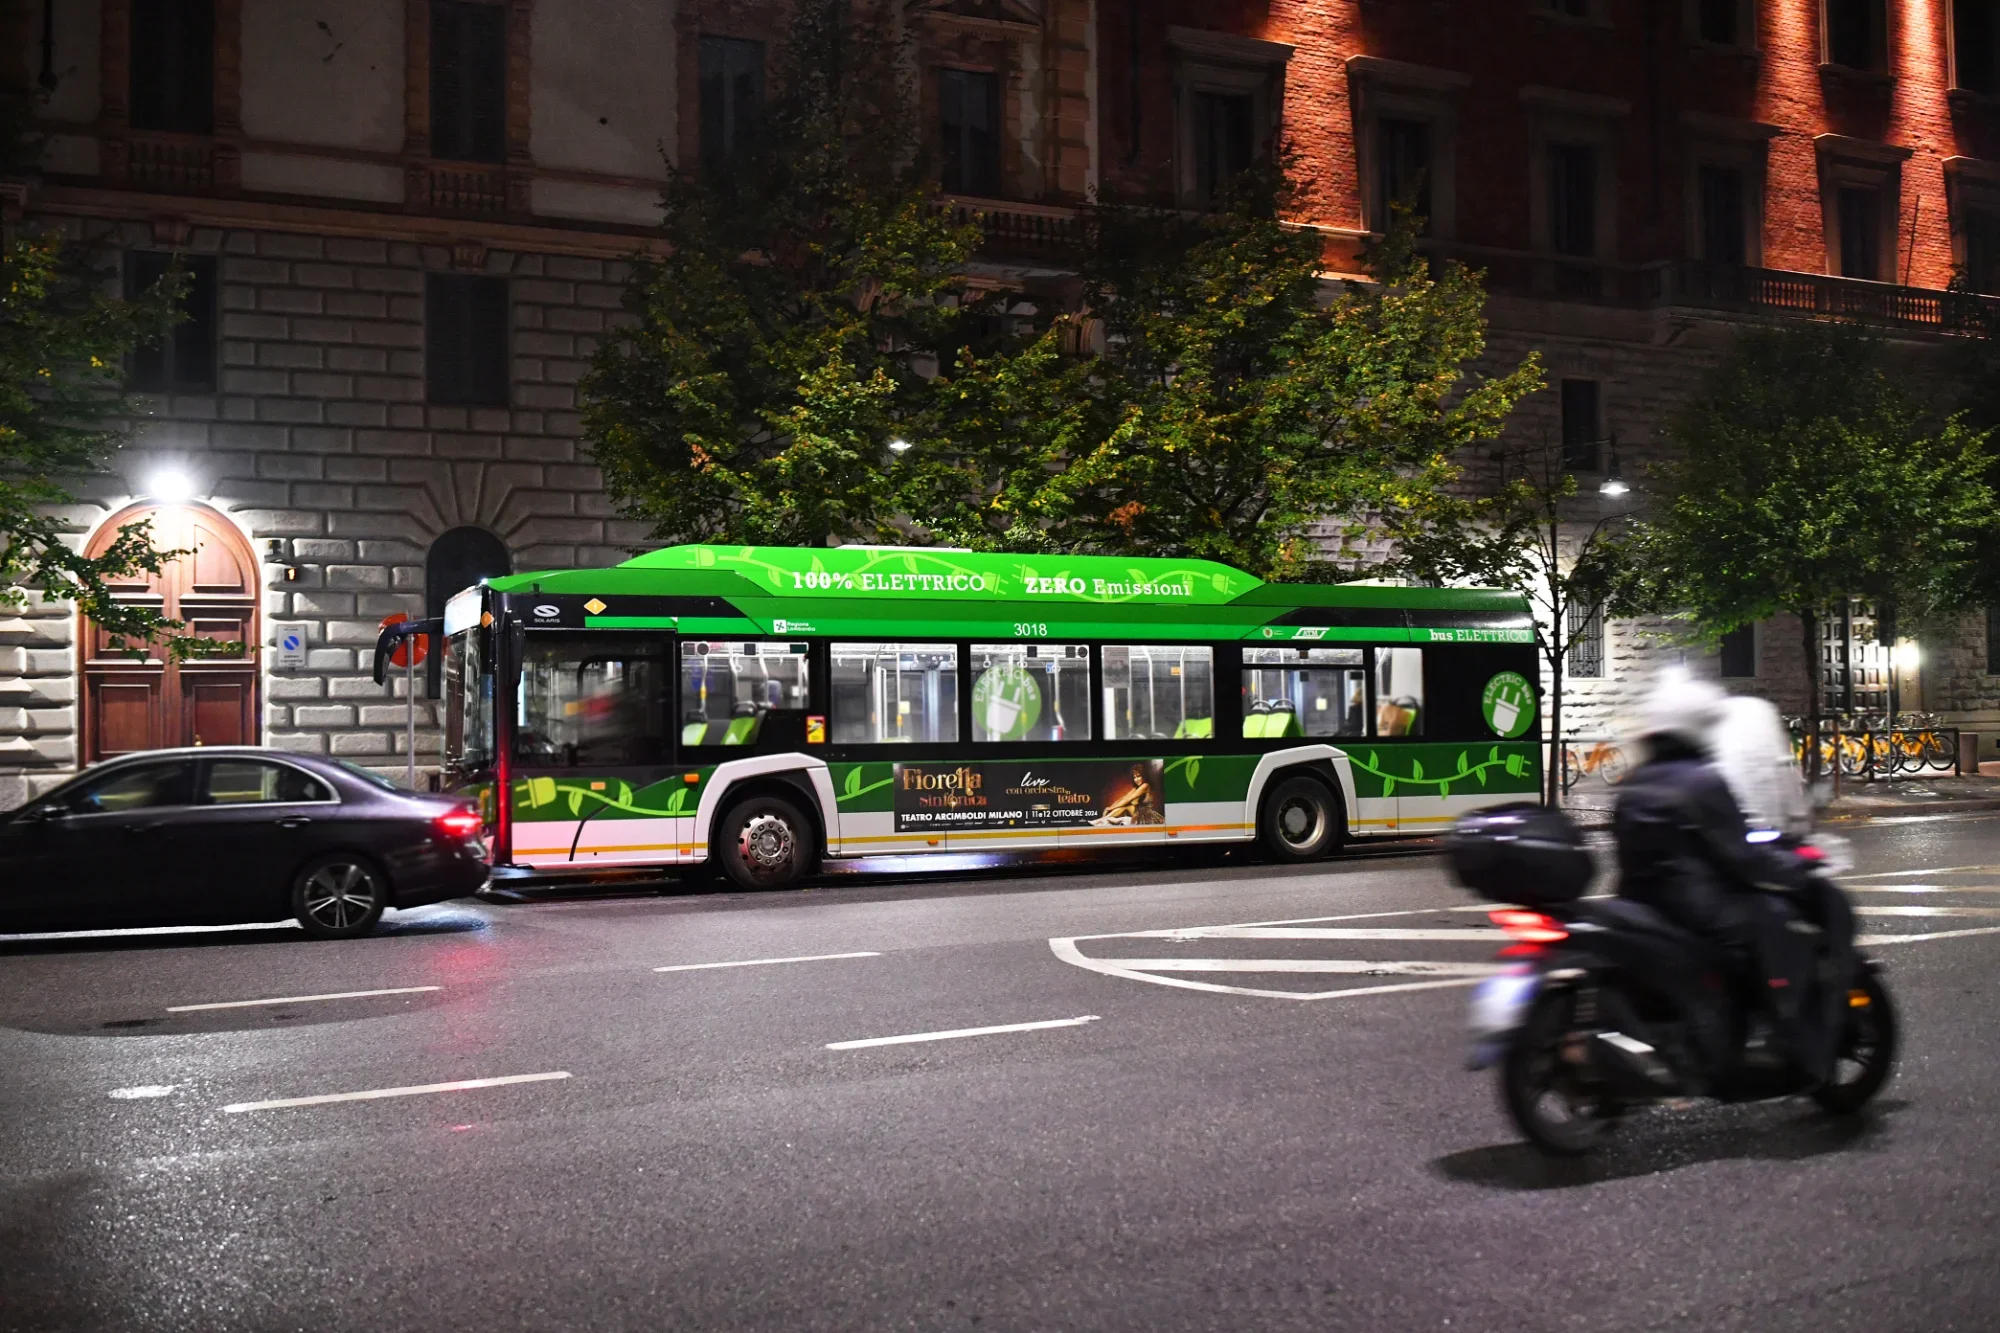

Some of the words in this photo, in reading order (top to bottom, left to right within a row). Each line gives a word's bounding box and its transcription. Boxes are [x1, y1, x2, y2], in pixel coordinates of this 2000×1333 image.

[792, 572, 853, 590] 100%
[861, 573, 986, 592] ELETTRICO
[1025, 577, 1086, 594] ZERO
[1092, 578, 1191, 597] Emissioni
[1013, 622, 1048, 637] 3018
[1429, 628, 1454, 641] bus
[1456, 629, 1529, 642] ELETTRICO
[1483, 673, 1522, 704] ELECTRIC
[1521, 683, 1532, 705] bus
[902, 766, 982, 796] Fiorella
[1020, 771, 1050, 787] live
[1005, 787, 1023, 795] con
[1024, 785, 1065, 794] orchestra
[1057, 793, 1091, 804] teatro
[901, 813, 933, 822] TEATRO
[934, 811, 986, 821] ARCIMBOLDI
[988, 810, 1023, 820] MILANO
[1052, 809, 1084, 817] OTTOBRE
